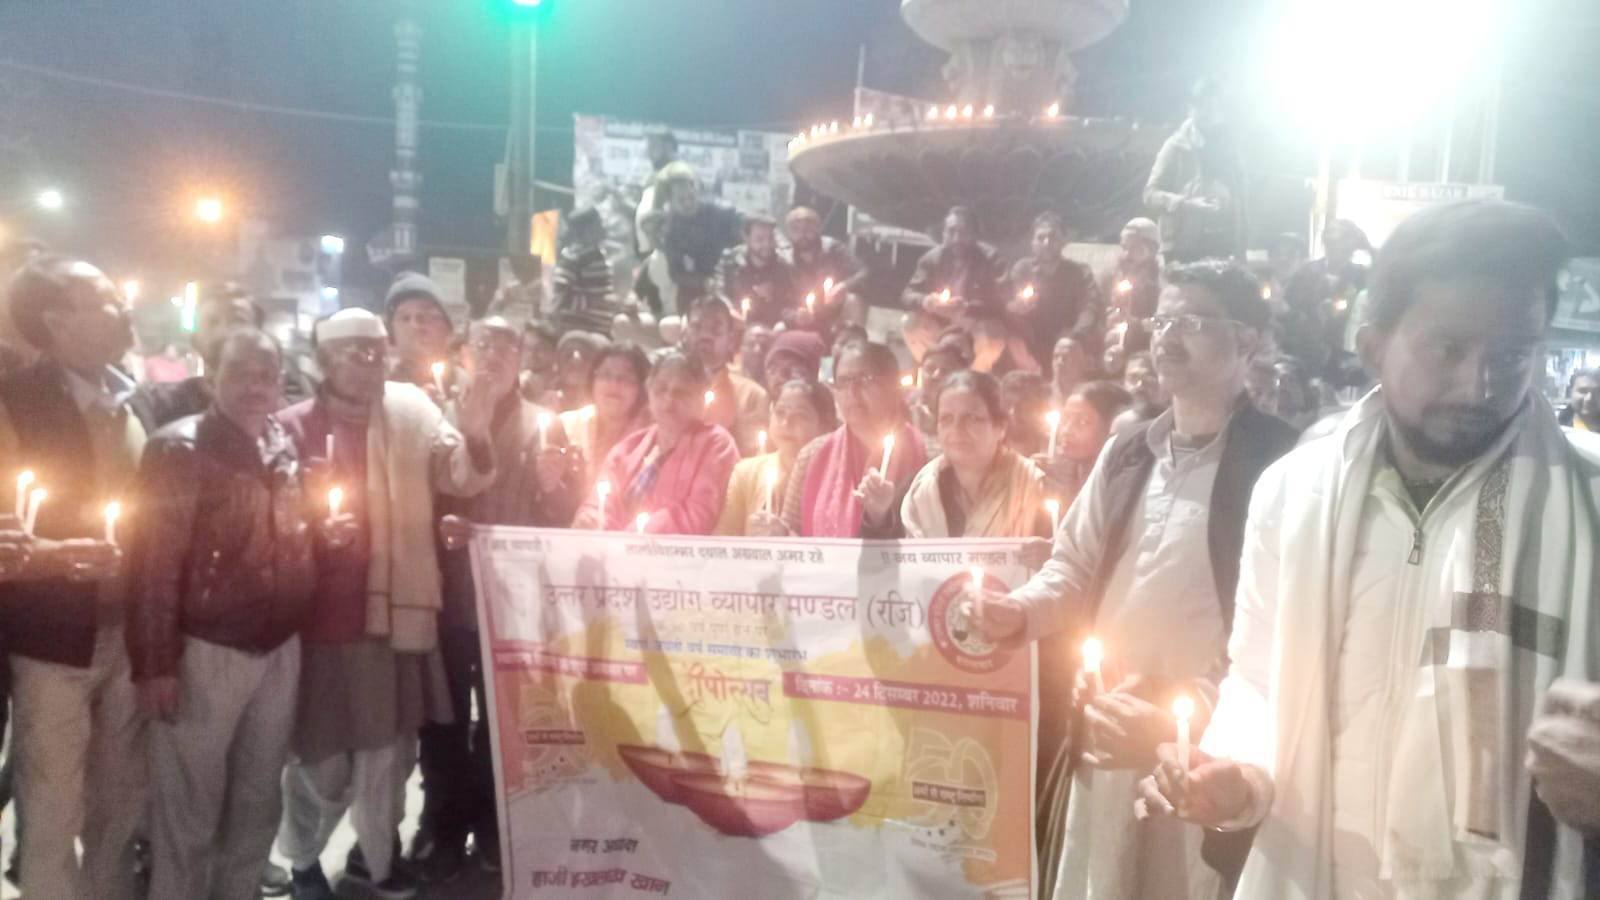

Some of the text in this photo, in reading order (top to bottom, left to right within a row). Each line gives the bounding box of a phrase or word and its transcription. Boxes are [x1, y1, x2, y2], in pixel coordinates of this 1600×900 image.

[776, 549, 804, 563] अमर
[808, 547, 825, 564] रहे
[919, 552, 963, 564] व्यापार
[592, 577, 641, 609] प्रदेश
[648, 579, 702, 611] उद्योग
[709, 589, 778, 615] व्यापार
[786, 593, 858, 622] मण्डल
[853, 683, 870, 699] 24
[922, 691, 963, 710] 2022,
[966, 691, 1018, 714] शनिवार
[630, 872, 672, 895] खान
